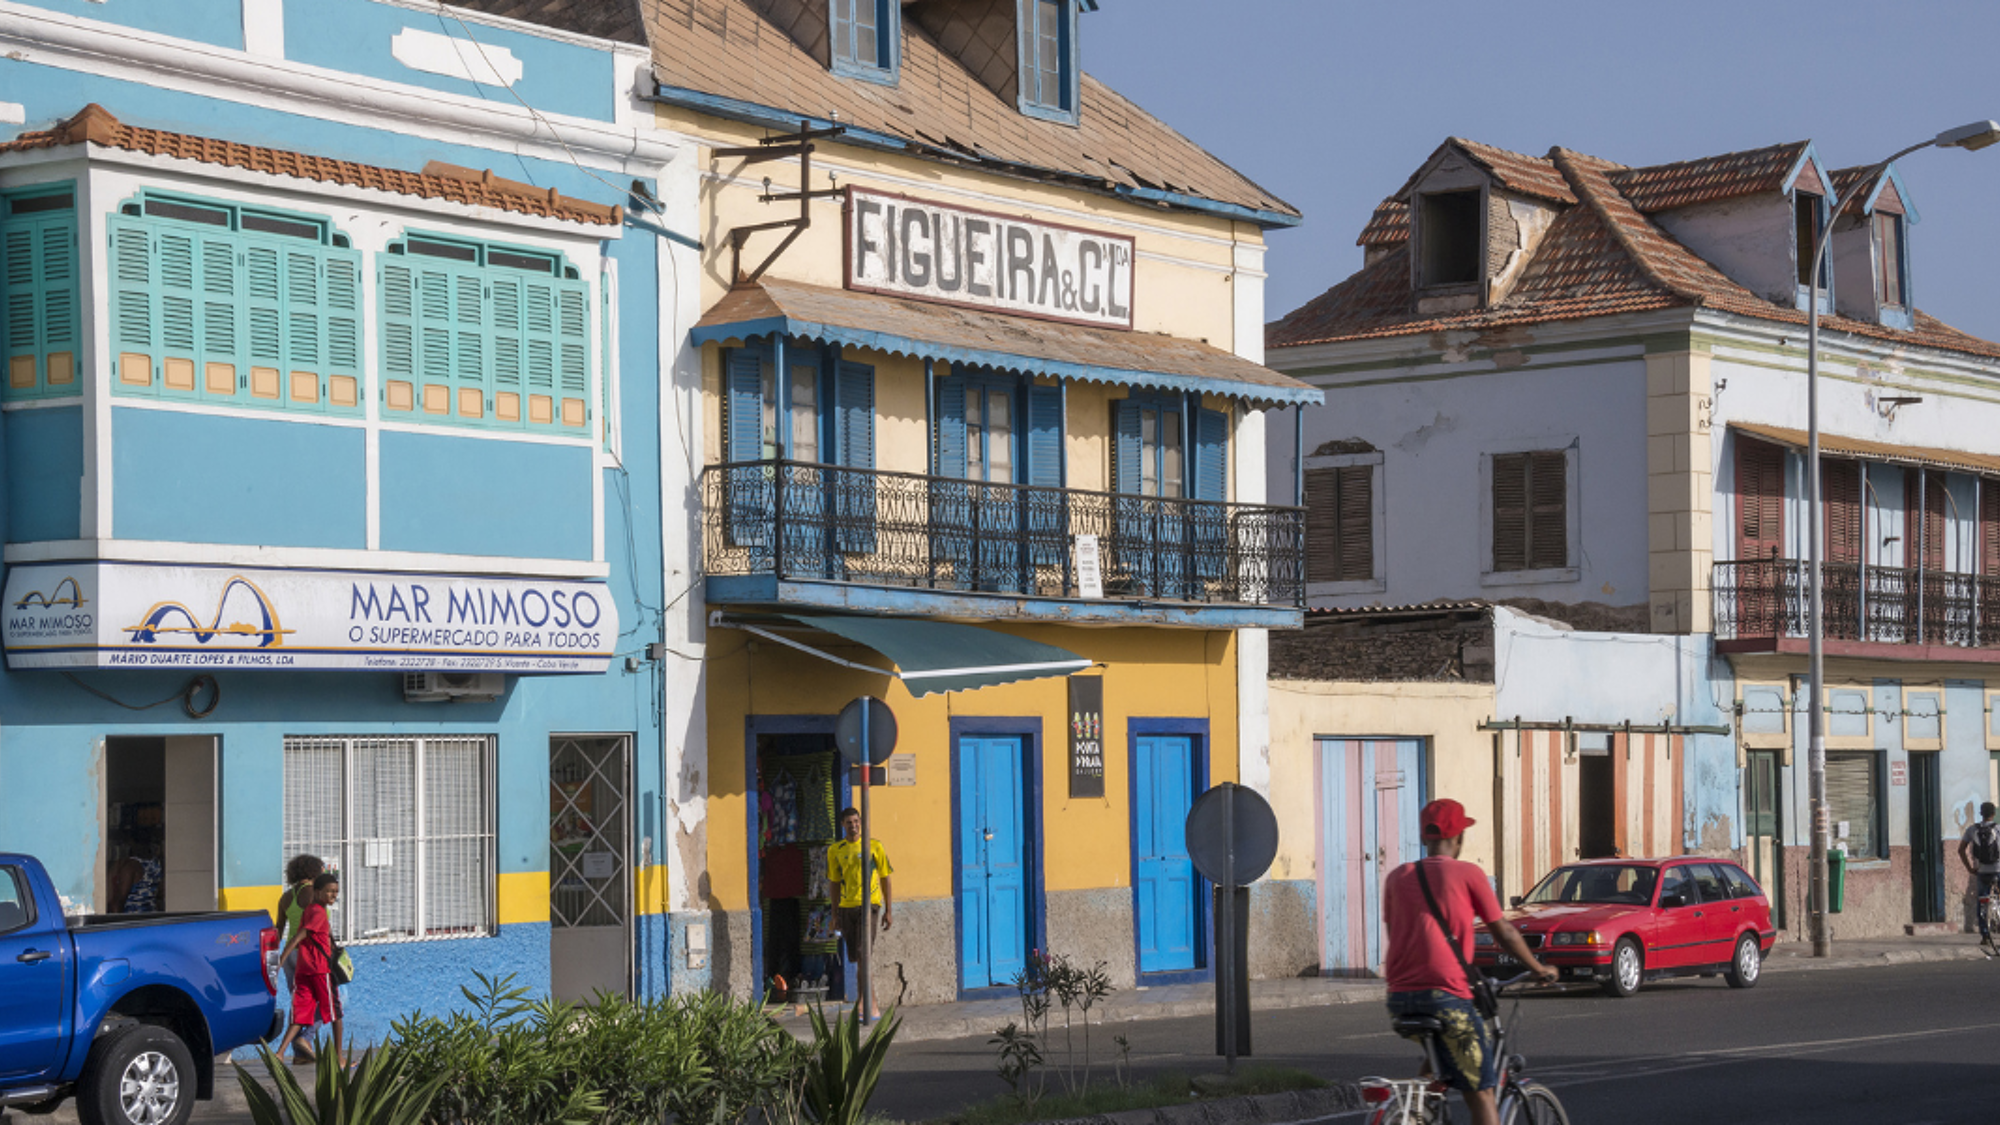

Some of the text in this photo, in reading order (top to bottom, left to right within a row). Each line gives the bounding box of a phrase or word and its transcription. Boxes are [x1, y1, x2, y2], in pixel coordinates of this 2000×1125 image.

[857, 199, 1060, 306] FIGUEIRA
[1061, 269, 1079, 311] &
[350, 582, 601, 629] MAR MIMOSO
[10, 614, 93, 630] MAR MIMOSO
[349, 625, 601, 648] O SUPERMERCADO PARA TODOS
[150, 654, 192, 664] DUARTE
[194, 654, 224, 664] LOPES
[227, 655, 234, 664] &
